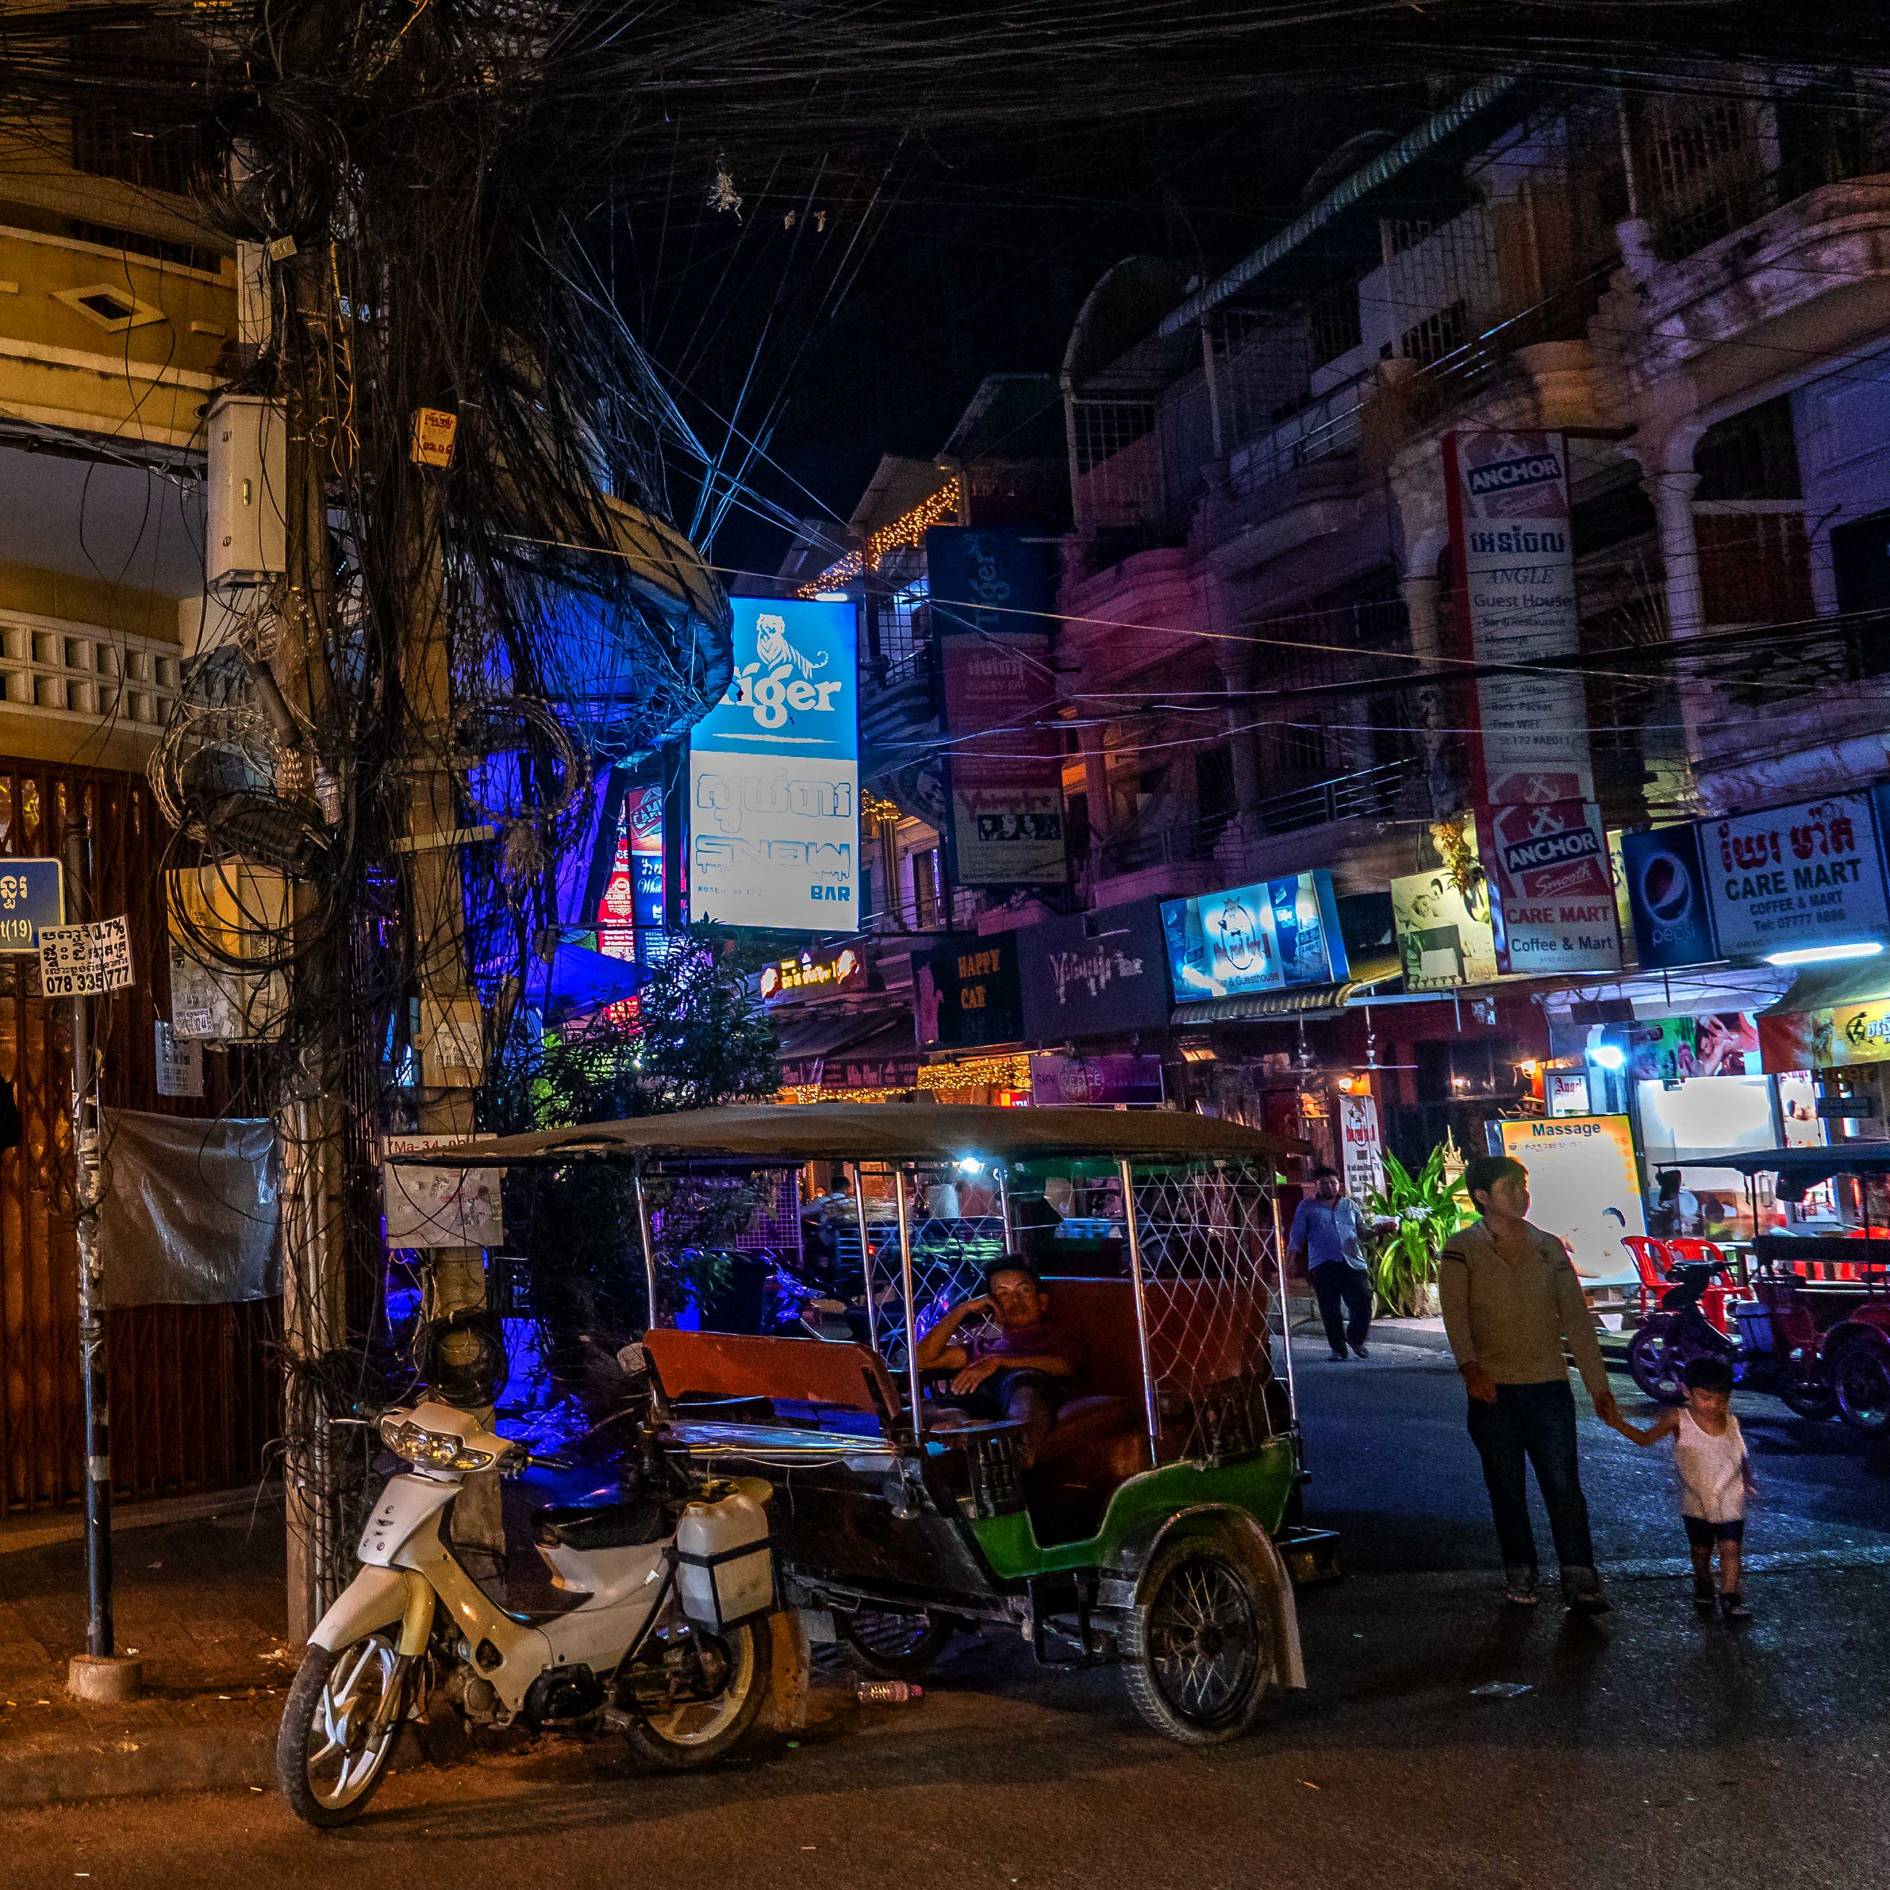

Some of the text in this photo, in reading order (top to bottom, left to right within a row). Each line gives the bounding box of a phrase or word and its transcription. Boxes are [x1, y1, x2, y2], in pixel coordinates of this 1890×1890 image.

[1472, 458, 1562, 491] ANCHOR
[1486, 568, 1554, 585] ANGLE
[1474, 592, 1573, 608] Guest House
[1509, 832, 1599, 870] ANCHOR
[1535, 862, 1593, 891] Smooth
[1726, 857, 1863, 902] CARE MART
[811, 885, 850, 902] BAR
[1749, 898, 1795, 916] COFFEE
[1808, 890, 1843, 907] MART
[1506, 906, 1610, 924] CARE MART
[0, 919, 32, 942] t(19)
[91, 917, 125, 941] 0.7%
[1651, 921, 1697, 948] pepsi
[1511, 935, 1614, 952] Coffee & Mart
[46, 965, 130, 994] 078 335 777
[1532, 1123, 1601, 1138] Massage
